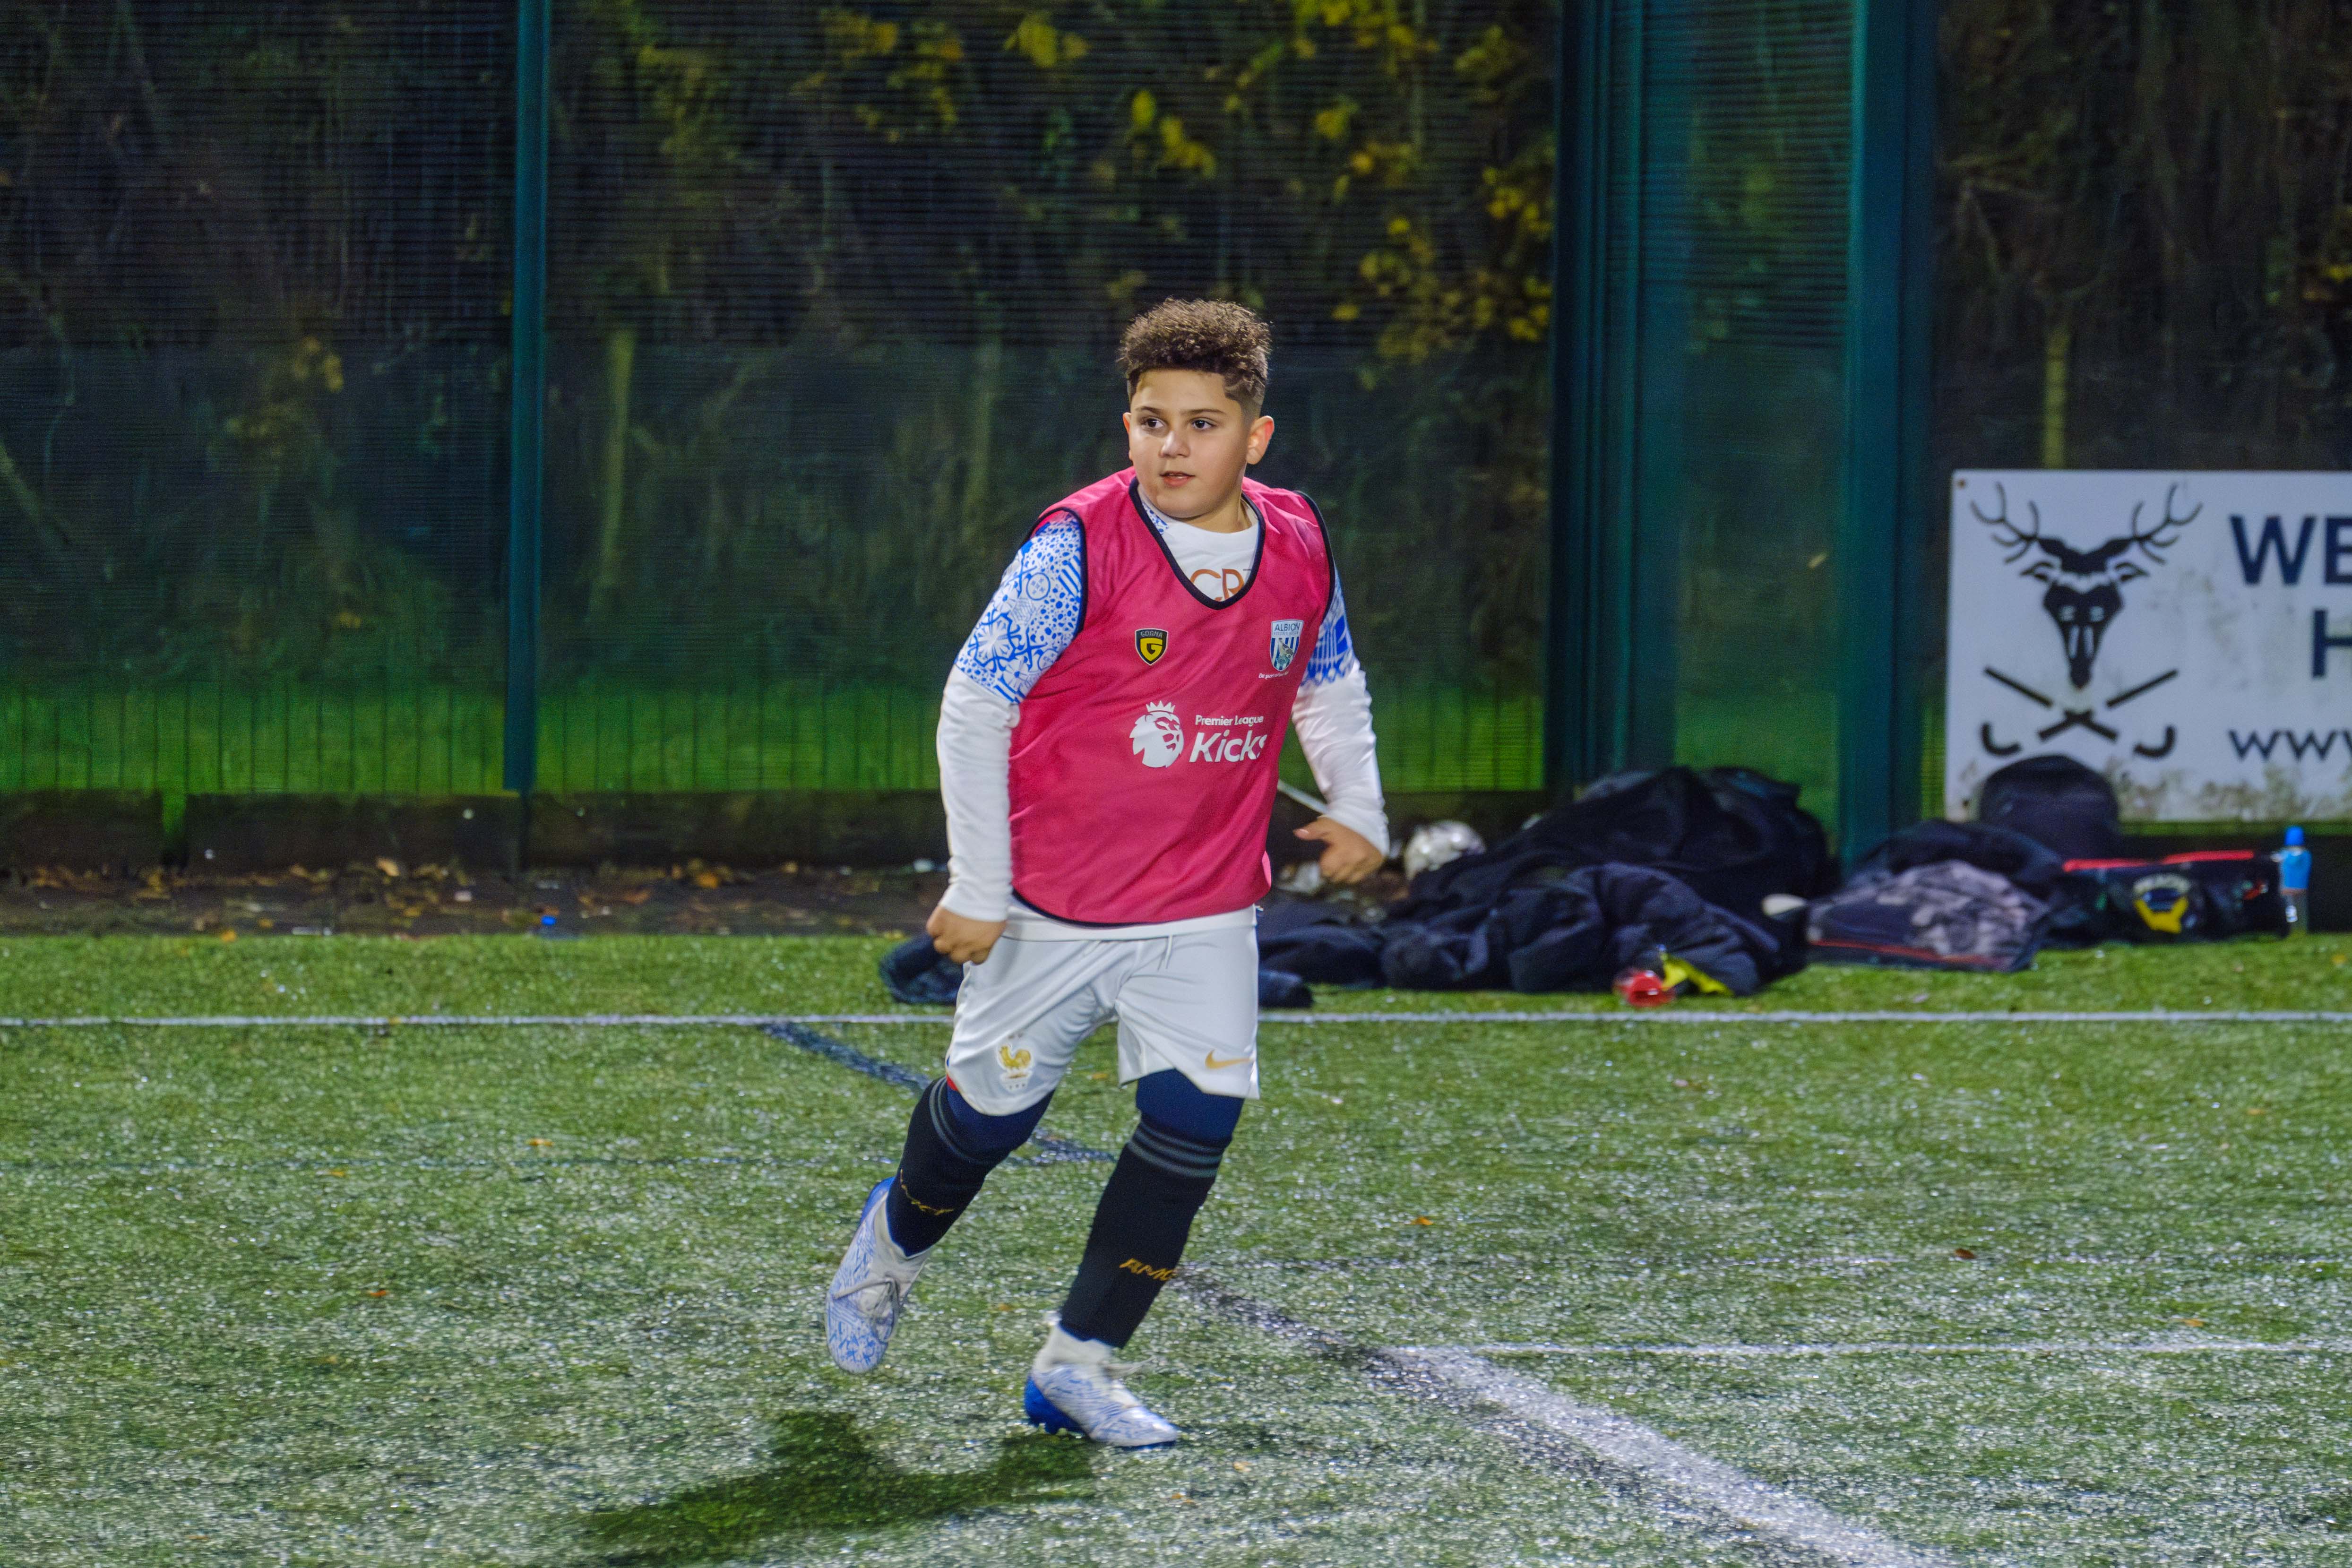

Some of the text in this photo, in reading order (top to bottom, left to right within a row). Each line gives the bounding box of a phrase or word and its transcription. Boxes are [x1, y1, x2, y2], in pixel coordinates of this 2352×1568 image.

[1275, 622, 1301, 631] ALBION
[1195, 715, 1264, 727] Premier League
